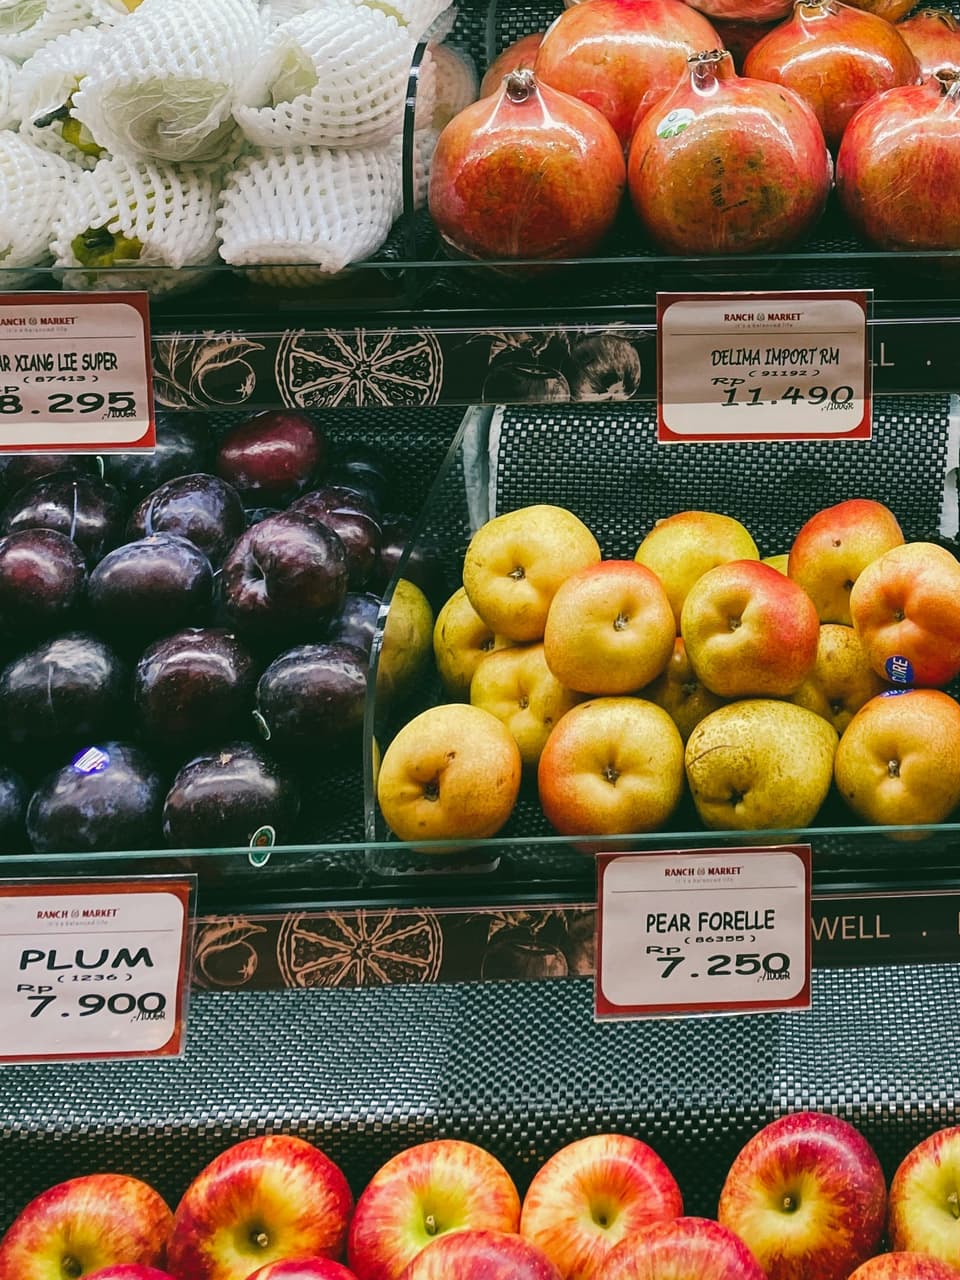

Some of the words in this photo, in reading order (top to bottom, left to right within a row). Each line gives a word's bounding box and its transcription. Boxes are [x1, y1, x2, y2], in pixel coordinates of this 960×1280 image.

[40, 317, 76, 325] MARKET
[724, 313, 754, 321] RANCH
[768, 313, 801, 321] MARKET
[14, 353, 54, 372] XIANG
[58, 352, 77, 371] LIE
[82, 352, 118, 371] SUPER
[711, 348, 760, 366] DELIMA
[765, 348, 817, 366] IMPORT
[819, 348, 840, 366] RM
[711, 377, 746, 387] Rp
[0, 391, 136, 415] 8.295
[721, 386, 854, 406] 11.490
[664, 867, 694, 877] RANCH
[708, 867, 741, 876] MARKET
[37, 910, 68, 919] RANCH
[82, 908, 118, 918] MARKET
[646, 913, 691, 933] PEAR
[698, 909, 775, 932] FORELLE
[811, 916, 890, 940] WELL
[19, 947, 154, 970] PLUM
[646, 946, 681, 956] Rp
[656, 952, 791, 979] 7.250
[17, 984, 53, 994] Rp
[27, 992, 166, 1018] 7.900
